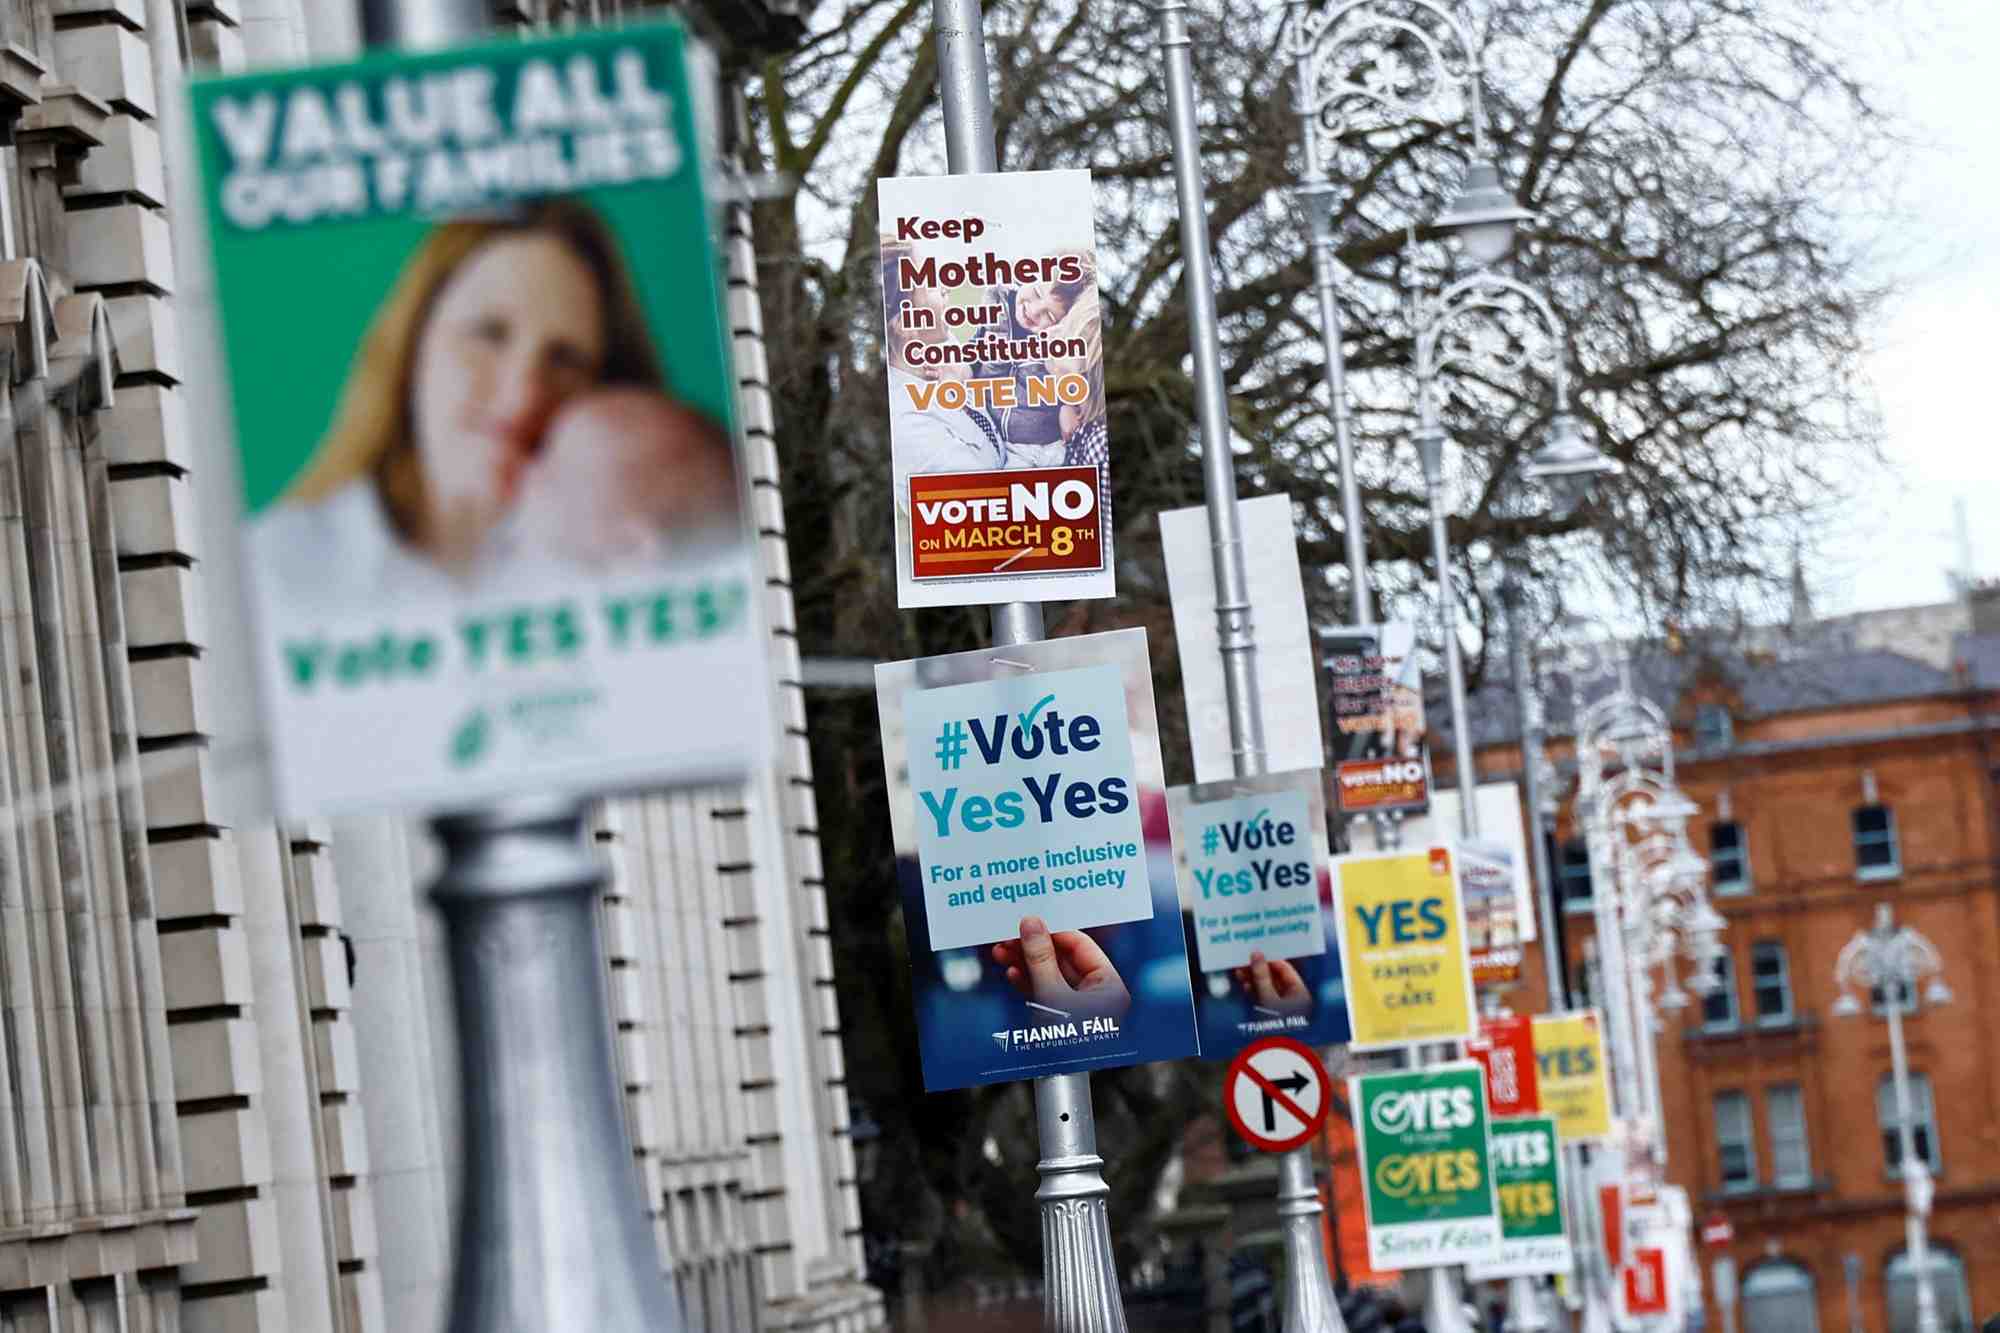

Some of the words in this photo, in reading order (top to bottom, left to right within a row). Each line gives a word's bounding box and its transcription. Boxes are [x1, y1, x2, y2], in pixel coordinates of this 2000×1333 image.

[211, 65, 497, 168] VALUE
[513, 49, 672, 130] ALL
[221, 162, 367, 227] OUR
[374, 128, 683, 212] FAMILIES
[896, 216, 985, 243] Keep
[899, 252, 1082, 290] Mothers
[902, 302, 935, 329] in
[944, 303, 1003, 326] our
[904, 332, 1087, 366] Constitution
[905, 377, 1017, 411] VOTE
[1027, 373, 1089, 406] NO
[916, 498, 1008, 526] VOTE
[1010, 479, 1095, 523] NO
[919, 538, 940, 550] ON
[944, 525, 1042, 549] MARCH
[281, 630, 440, 690] Vote
[458, 602, 587, 670] YES
[935, 695, 1101, 770] #Vote
[1382, 760, 1422, 783] NO
[919, 773, 1129, 837] YesYes
[1201, 808, 1295, 856] #Vote
[931, 864, 964, 883] For
[970, 863, 982, 878] a
[987, 854, 1040, 875] more
[1045, 841, 1138, 869] inclusive
[1193, 859, 1311, 900] YesYes
[947, 884, 985, 907] and
[990, 876, 1046, 904] equal
[1053, 868, 1126, 894] society
[1355, 896, 1448, 946] YES
[1013, 1022, 1077, 1045] FIANNA
[1083, 1016, 1120, 1036] FÁIL
[1014, 1044, 1031, 1052] THE
[1036, 1036, 1090, 1049] REPUBLICAN
[1093, 1032, 1120, 1042] PARTY
[1537, 1045, 1596, 1080] YES
[1405, 1086, 1475, 1132] YES
[1498, 1130, 1551, 1168] YES
[1410, 1149, 1481, 1193] YES
[1499, 1181, 1555, 1217] YES
